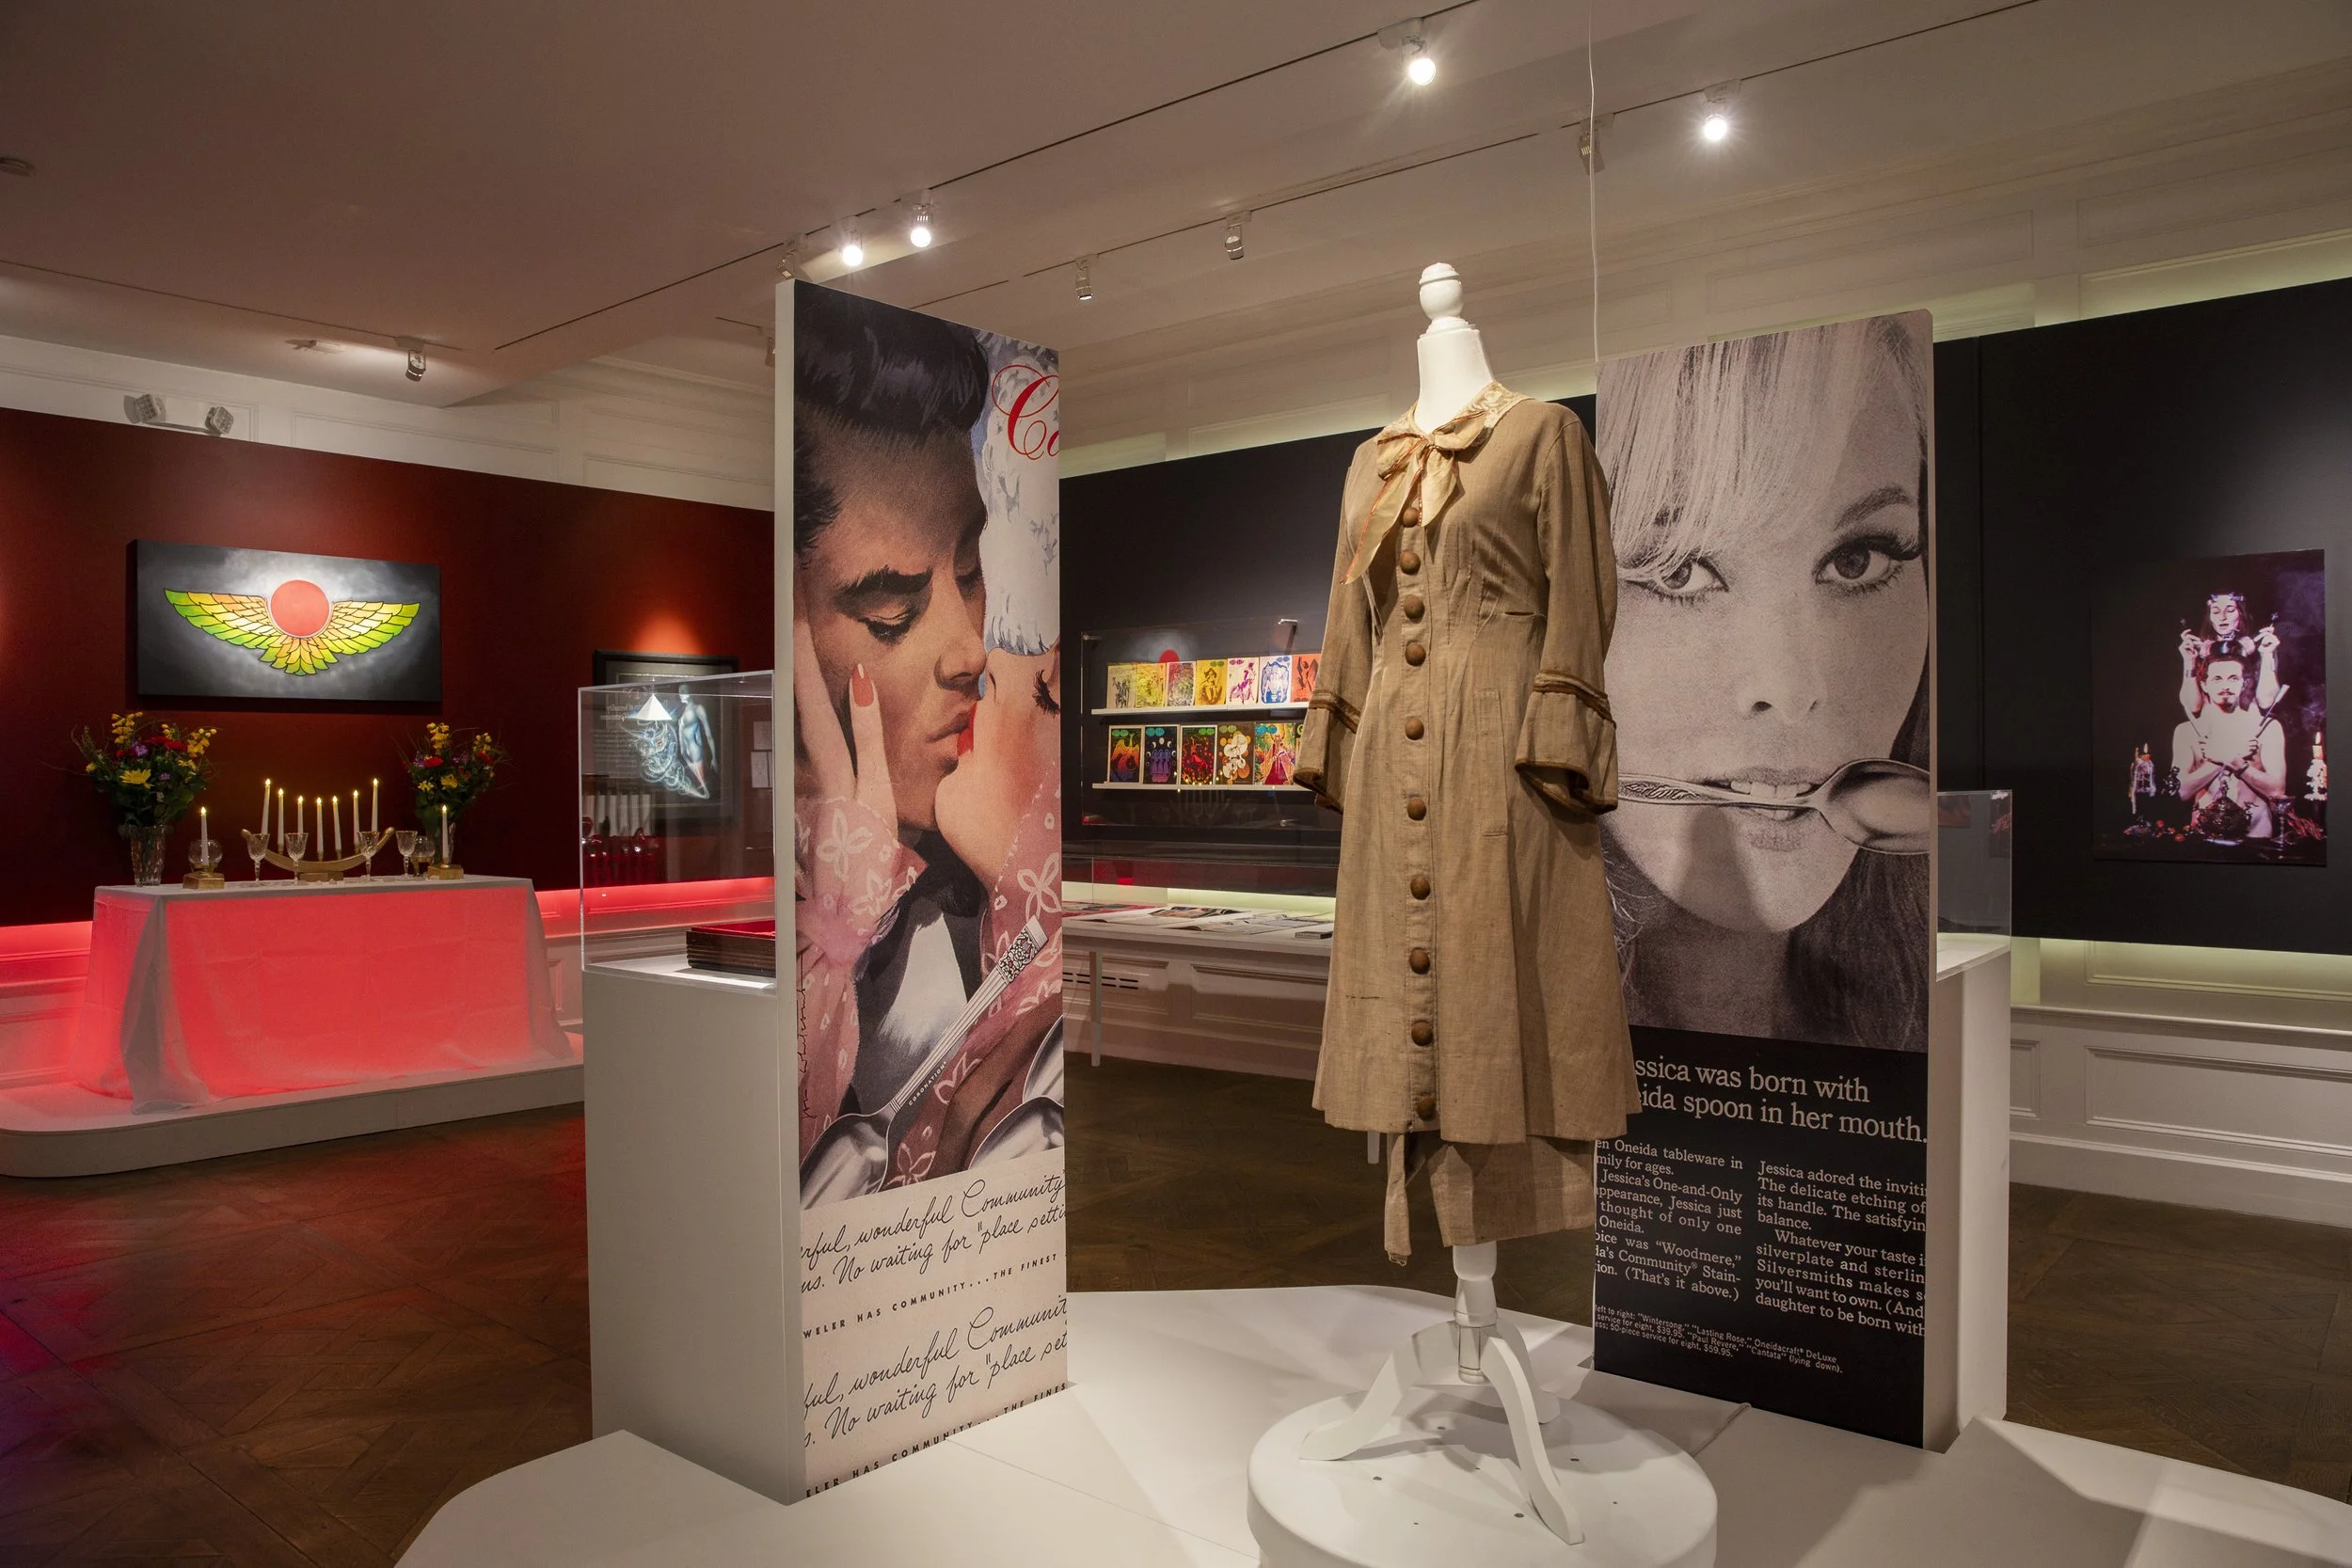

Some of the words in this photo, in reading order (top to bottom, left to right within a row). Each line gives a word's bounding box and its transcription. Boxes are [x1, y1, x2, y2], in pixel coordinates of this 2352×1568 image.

[1634, 1054, 1692, 1082] ssica
[1694, 1066, 1742, 1088] was
[1749, 1066, 1807, 1096] born
[1814, 1075, 1870, 1102] with
[1640, 1083, 1677, 1110] ida
[1683, 1096, 1754, 1120] spoon
[1760, 1099, 1784, 1124] in
[1790, 1102, 1834, 1130] her
[1838, 1115, 1928, 1144] mouth.
[1614, 1139, 1658, 1157] Oneida
[1662, 1148, 1725, 1166] tableware
[1730, 1156, 1743, 1170] in
[1625, 1156, 1643, 1170] for
[1645, 1163, 1674, 1176] ages.
[1600, 1168, 1650, 1187] Jessica’s
[1653, 1178, 1742, 1204] One-and-Only
[1757, 1161, 1804, 1179] Jessica
[1807, 1169, 1855, 1187] adored
[1859, 1176, 1883, 1190] the
[1668, 1196, 1711, 1214] Jessica
[1717, 1204, 1742, 1219] just
[1757, 1177, 1786, 1193] The
[1789, 1182, 1847, 1202] delicate
[1851, 1193, 1906, 1214] etching
[1911, 1200, 1927, 1214] of
[1757, 1193, 1773, 1208] its
[1777, 1196, 1827, 1216] handle.
[1832, 1205, 1861, 1221] The
[1865, 1212, 1926, 1232] satisfyin
[801, 1225, 850, 1271] rful,
[854, 1195, 954, 1246] wonderful
[961, 1174, 1064, 1218] Community
[1599, 1214, 1645, 1233] Oneida.
[1600, 1200, 1653, 1220] thought
[1659, 1212, 1673, 1223] of
[1678, 1215, 1710, 1232] only
[1716, 1223, 1742, 1235] one
[1757, 1210, 1812, 1230] balance.
[833, 1255, 865, 1285] No
[870, 1243, 934, 1275] waiting
[942, 1228, 973, 1263] for
[1027, 1204, 1066, 1234] setti
[1625, 1237, 1648, 1250] was
[1656, 1240, 1741, 1268] “Woodmere,”
[1774, 1228, 1842, 1252] Whatever
[1844, 1244, 1878, 1259] your
[1881, 1249, 1916, 1265] taste
[1596, 1260, 1617, 1275] ion.
[1625, 1266, 1670, 1286] (That’s
[1676, 1275, 1685, 1290] it
[1692, 1282, 1740, 1302] above.)
[1702, 1265, 1740, 1283] Stain-
[1756, 1243, 1835, 1267] silverplate
[1839, 1261, 1868, 1274] and
[1874, 1265, 1925, 1284] sterlin
[1756, 1259, 1853, 1288] Silversmiths
[1859, 1280, 1910, 1299] makes
[803, 1319, 846, 1336] WELER
[857, 1307, 882, 1323] HAS
[993, 1267, 1012, 1280] THE
[1021, 1254, 1057, 1271] FINEST
[1756, 1276, 1793, 1293] you’ll
[1795, 1284, 1830, 1301] want
[1833, 1291, 1847, 1304] to
[1849, 1296, 1882, 1310] own.
[1885, 1299, 1924, 1319] (And
[1756, 1292, 1817, 1315] daughter
[1820, 1305, 1834, 1318] to
[1837, 1307, 1854, 1322] be
[1858, 1311, 1891, 1329] born
[1597, 1314, 1620, 1324] service
[1622, 1317, 1632, 1326] for
[1608, 1306, 1614, 1316] to
[1805, 1349, 1836, 1363] DeLuxe
[1642, 1331, 1666, 1343] service
[1668, 1336, 1678, 1345] for
[849, 1327, 960, 1395] wonderful
[824, 1406, 860, 1439] No
[866, 1383, 937, 1422] waiting
[946, 1365, 979, 1402] for
[852, 1461, 879, 1479] HAS
[1003, 1400, 1024, 1414] THE
